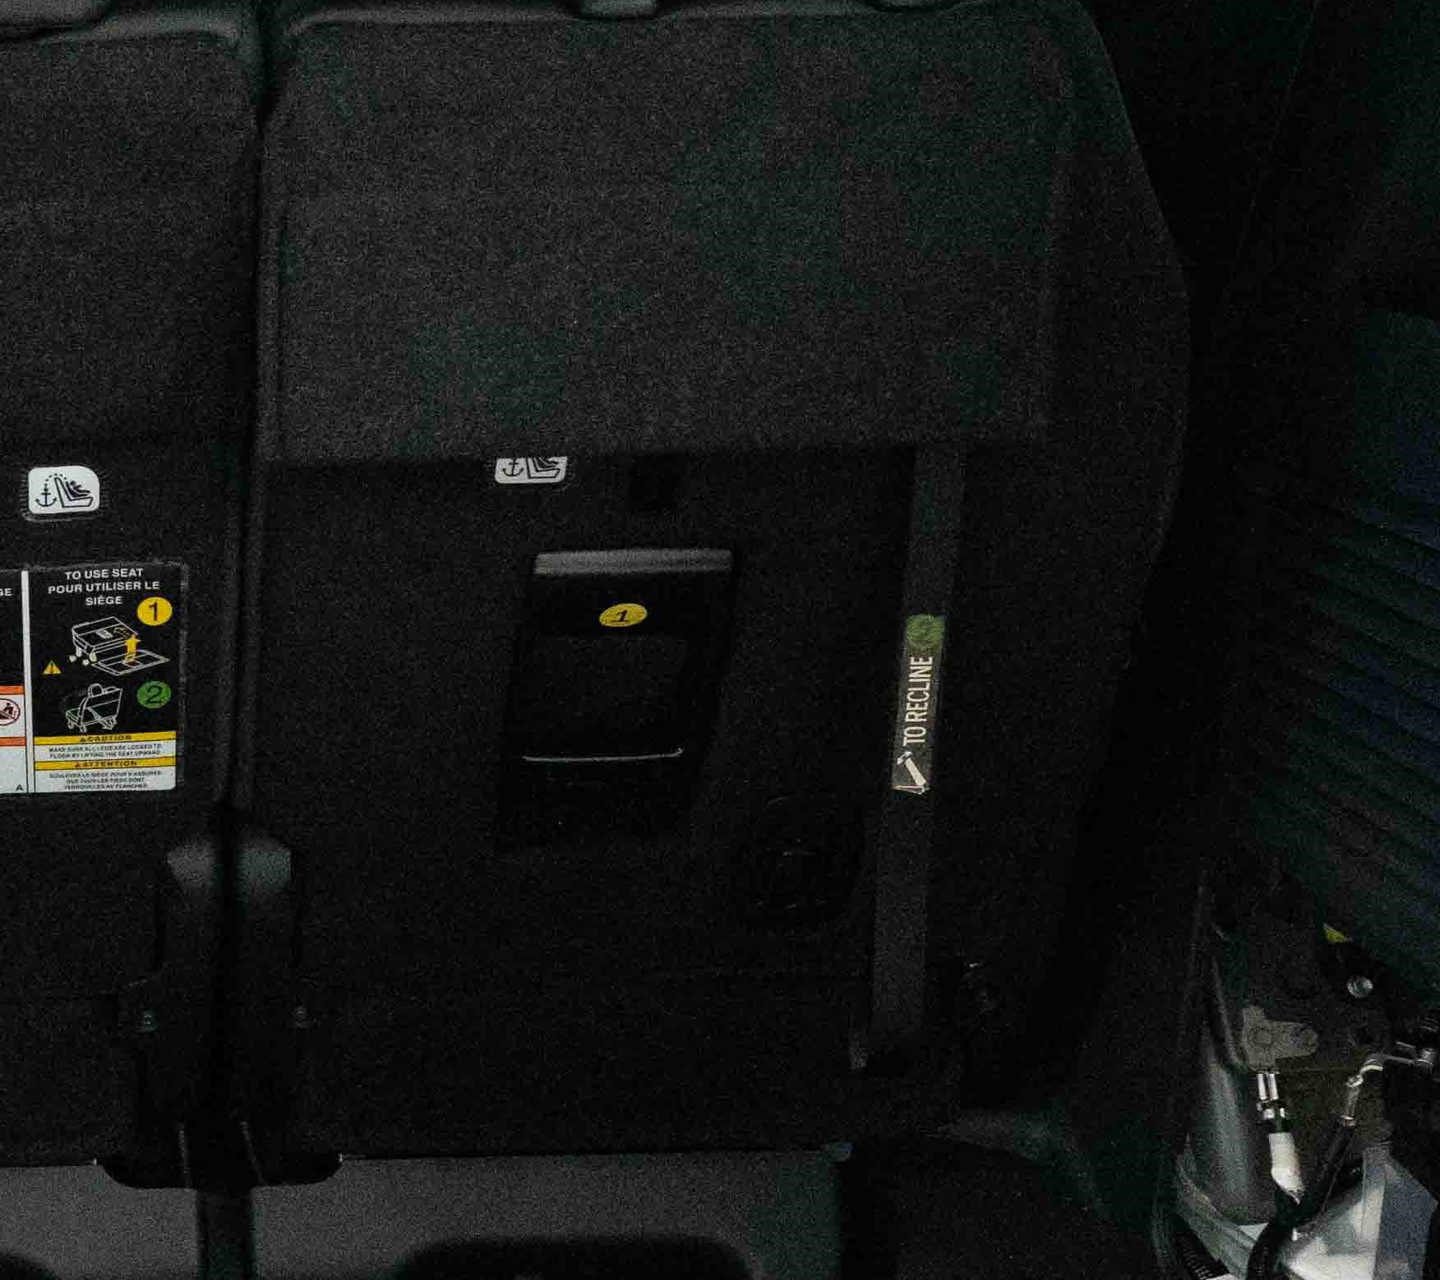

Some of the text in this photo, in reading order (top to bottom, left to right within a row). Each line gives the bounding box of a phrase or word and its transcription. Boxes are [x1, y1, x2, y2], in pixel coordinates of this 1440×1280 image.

[64, 568, 144, 580] TO USE SEAT
[48, 581, 160, 594] POUR UTILISER LE
[902, 656, 934, 747] TO RECLINE
